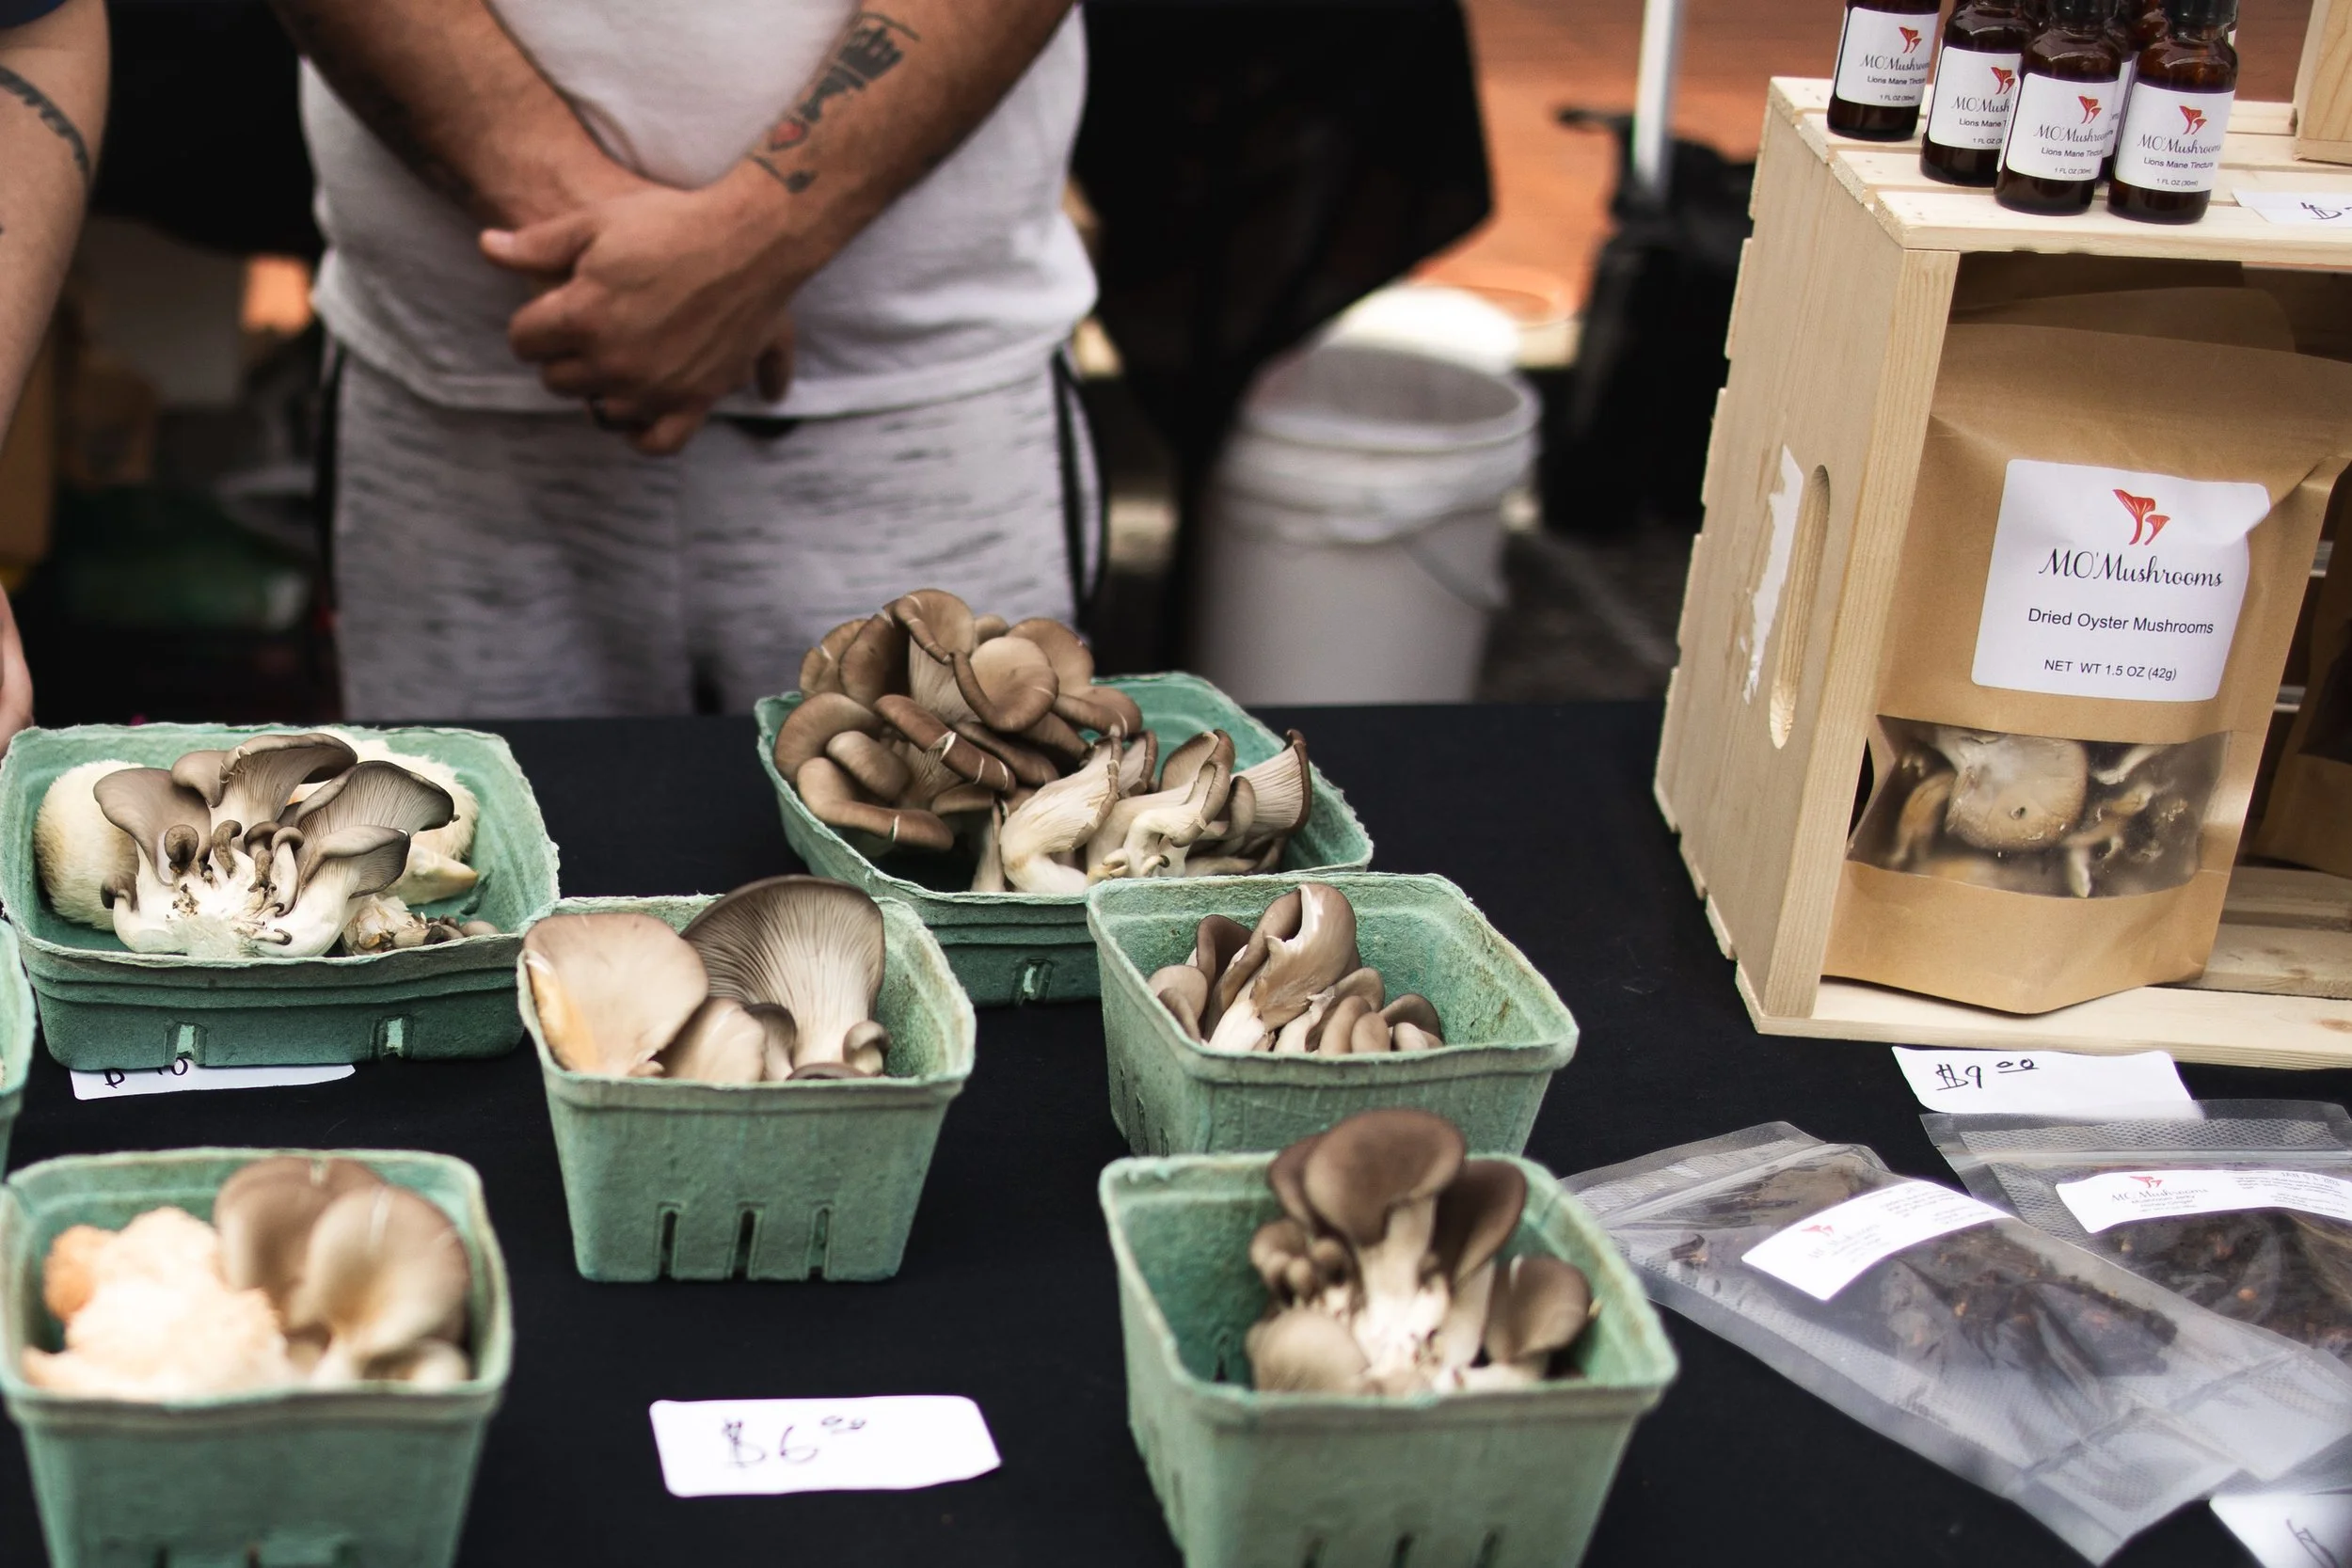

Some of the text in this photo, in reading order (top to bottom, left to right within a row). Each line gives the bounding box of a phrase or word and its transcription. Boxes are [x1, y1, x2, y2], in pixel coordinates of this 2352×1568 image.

[1867, 75, 1886, 84] Lions
[1950, 96, 2010, 113] MO'Mush
[1959, 118, 1979, 127] Lions
[1981, 119, 2002, 128] Mane
[2041, 147, 2062, 156] Lions
[2144, 156, 2164, 166] Lions
[2166, 160, 2188, 168] Mane
[2028, 608, 2214, 634] Dried Oyster Mushrooms
[2044, 659, 2177, 681] NET WT 1.5 OZ (42g)
